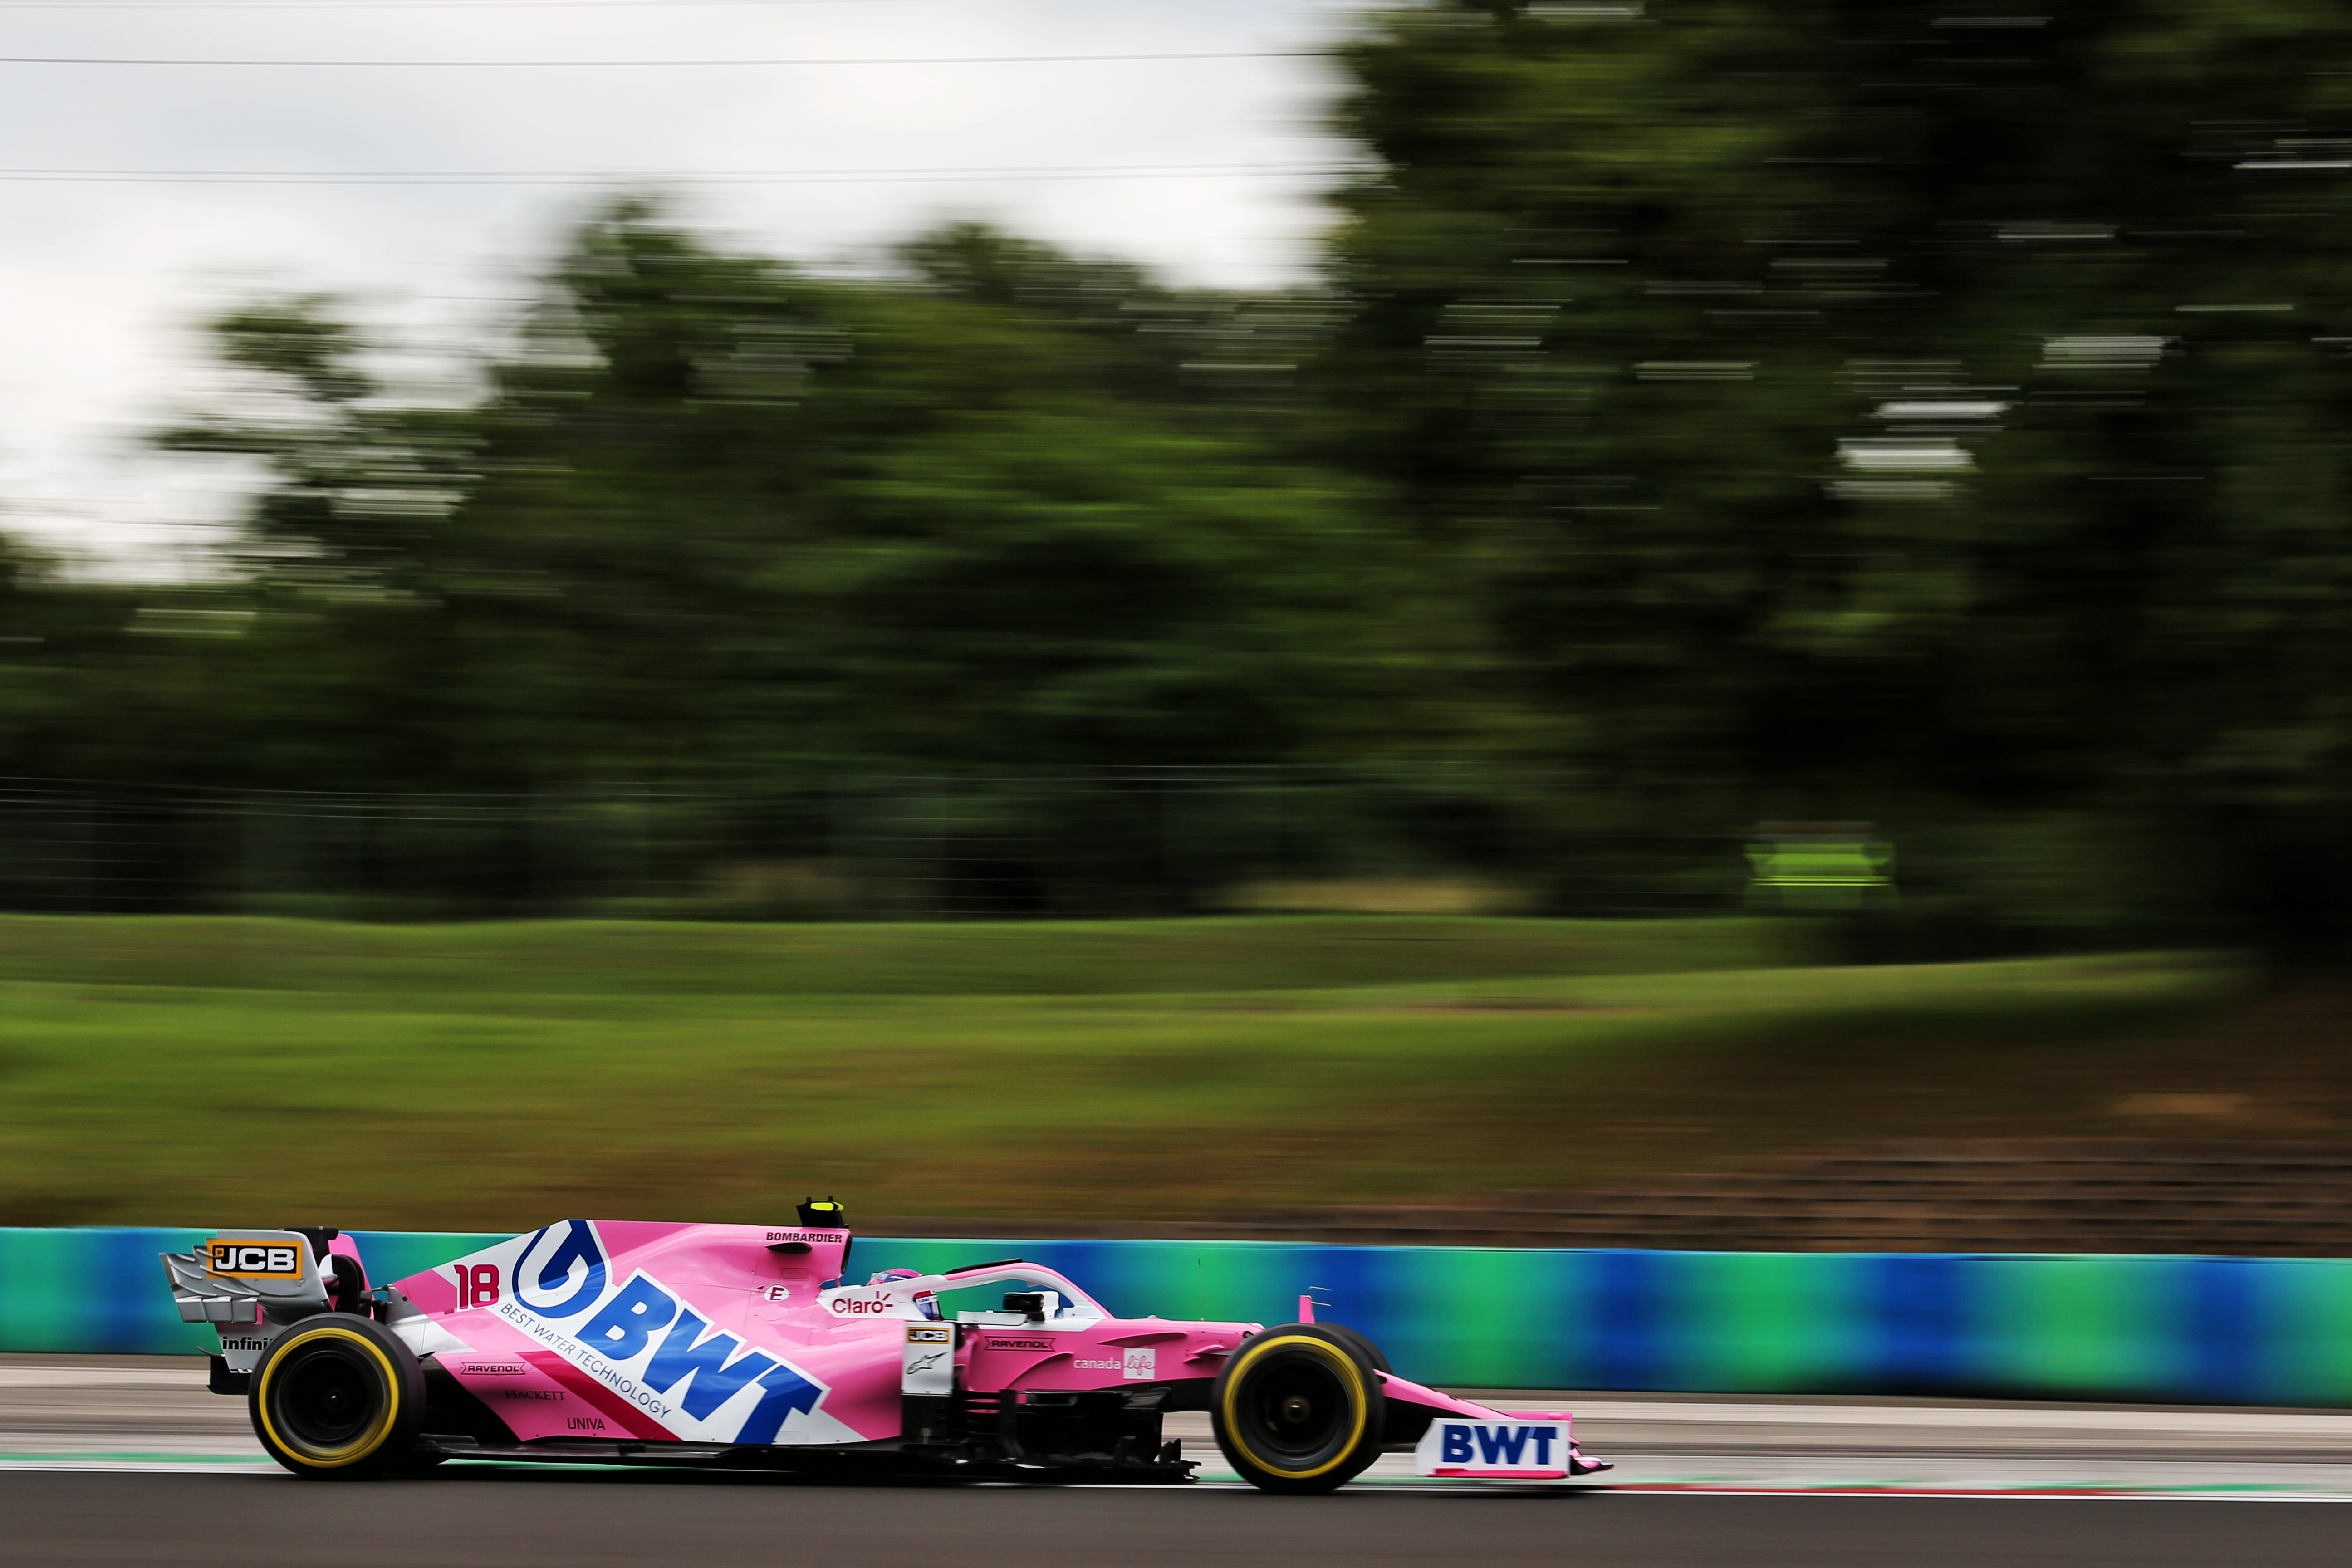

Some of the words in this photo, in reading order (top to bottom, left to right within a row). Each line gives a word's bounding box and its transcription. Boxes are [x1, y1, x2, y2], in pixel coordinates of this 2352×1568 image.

[766, 1232, 842, 1243] BOMBARDIER
[215, 1247, 294, 1270] JCB
[454, 1264, 499, 1309] 18
[770, 1286, 784, 1301] E
[833, 1298, 883, 1313] Claro
[910, 1330, 948, 1341] JCB
[222, 1336, 273, 1351] infini
[991, 1340, 1048, 1348] RAVENOL
[500, 1303, 535, 1328] BEST
[534, 1323, 576, 1355] WATER
[576, 1349, 671, 1418] TECHNOLOGY
[575, 1275, 823, 1443] BWT
[1073, 1357, 1122, 1370] canada
[1123, 1355, 1156, 1376] life
[504, 1390, 565, 1401] HACKETT
[567, 1417, 606, 1430] UNIVA
[1441, 1424, 1559, 1465] BWT
